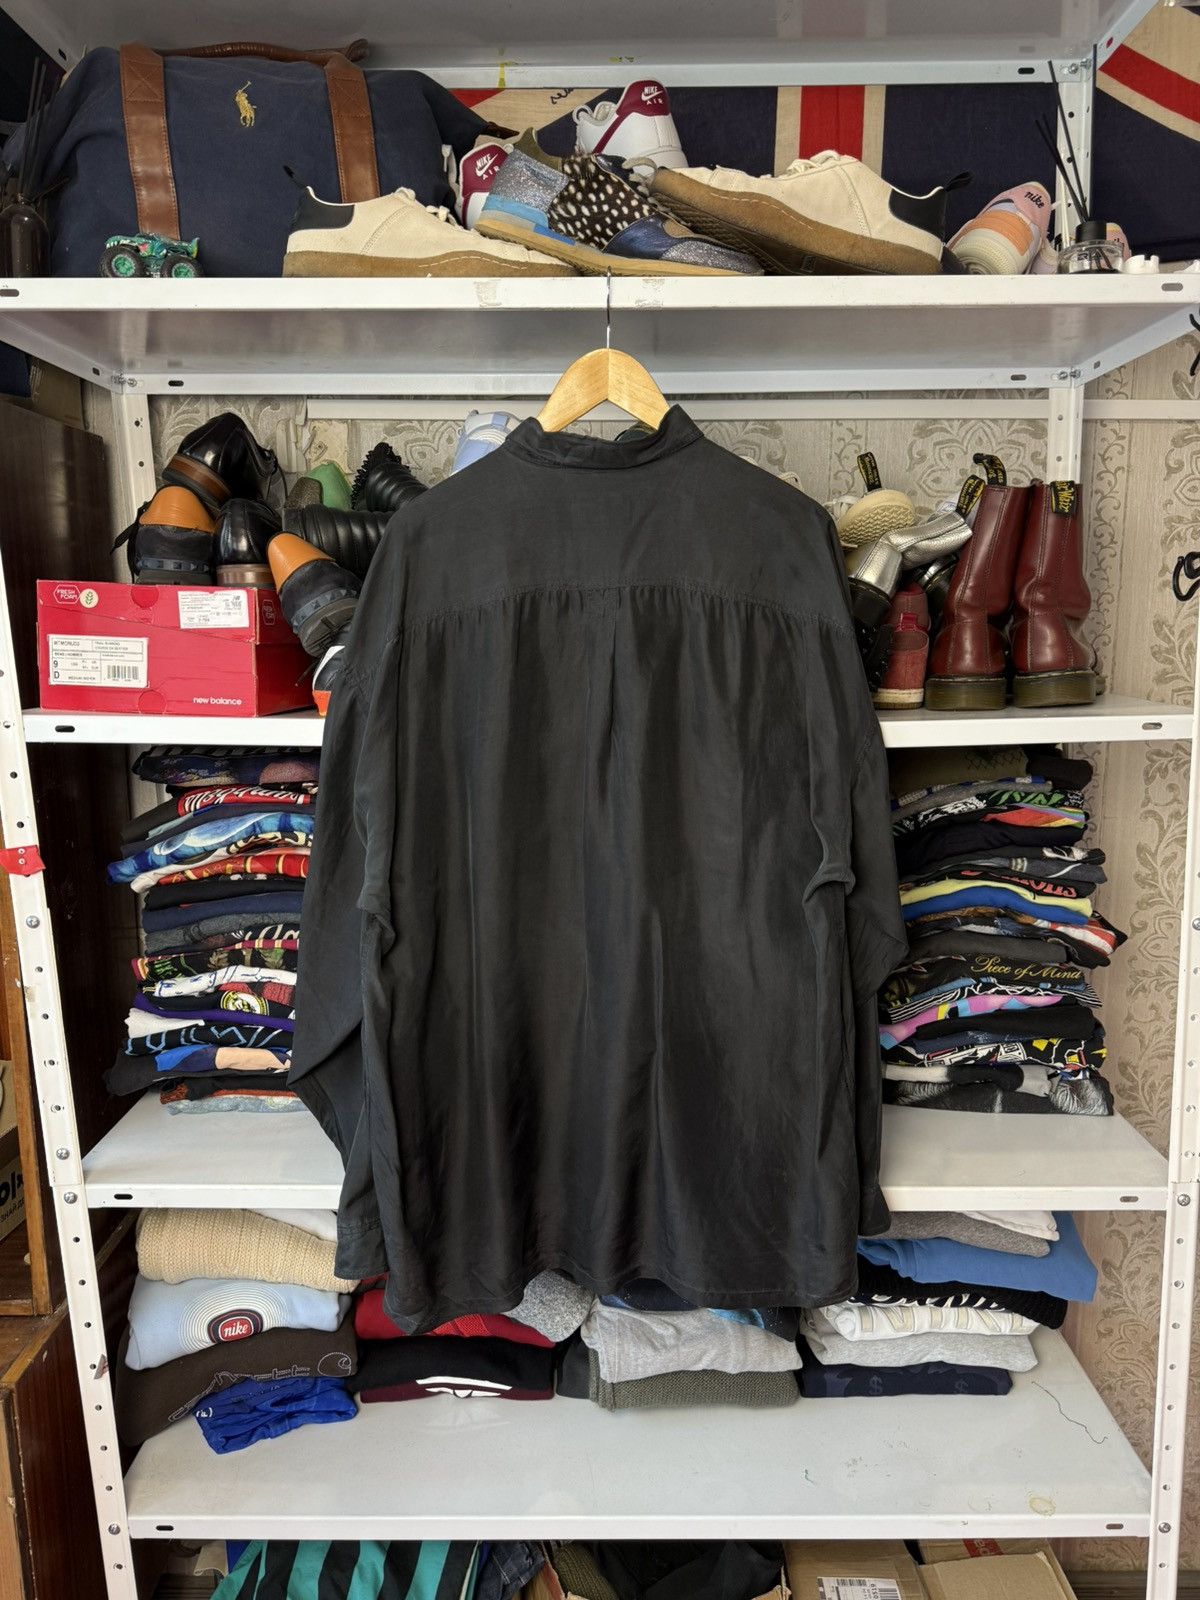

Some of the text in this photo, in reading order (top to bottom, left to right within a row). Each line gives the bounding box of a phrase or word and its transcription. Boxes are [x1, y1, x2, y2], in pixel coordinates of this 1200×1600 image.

[643, 86, 658, 94] NIKE
[476, 153, 491, 169] NIKE
[482, 165, 500, 180] AIR
[1024, 191, 1045, 209] nike
[53, 660, 59, 669] 9
[53, 670, 60, 679] D
[210, 696, 242, 705] balance
[971, 956, 1082, 981] Piece of Mind
[223, 1321, 249, 1338] nike
